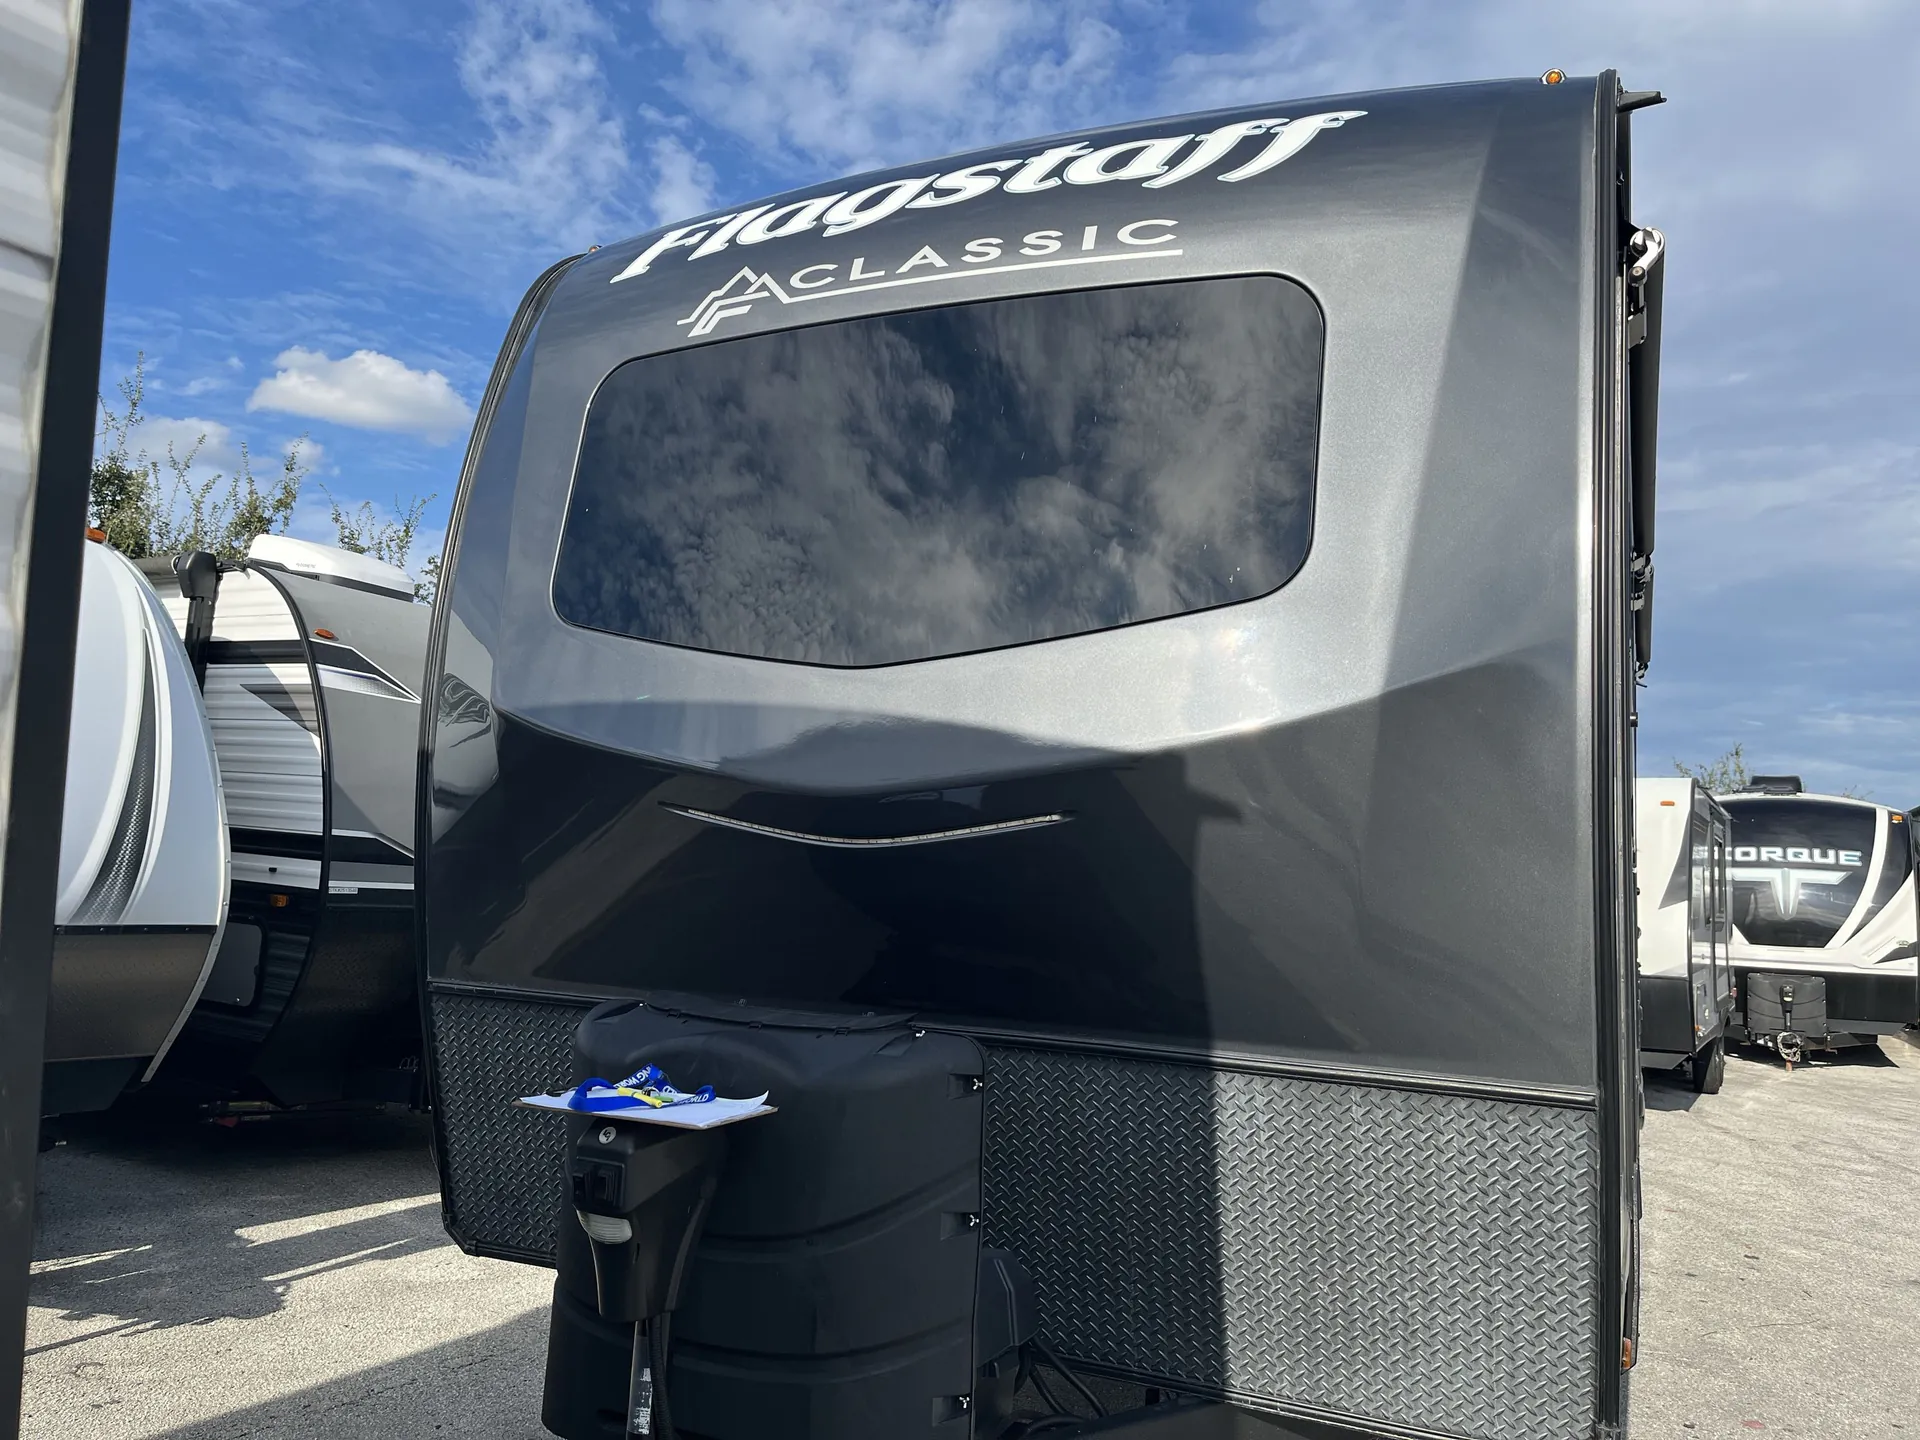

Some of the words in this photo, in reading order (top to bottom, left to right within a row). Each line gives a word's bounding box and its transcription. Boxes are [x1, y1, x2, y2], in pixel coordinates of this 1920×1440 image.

[609, 110, 1368, 284] Flagstaff
[789, 219, 1180, 289] CLASSIC
[1733, 845, 1863, 867] ORQUE
